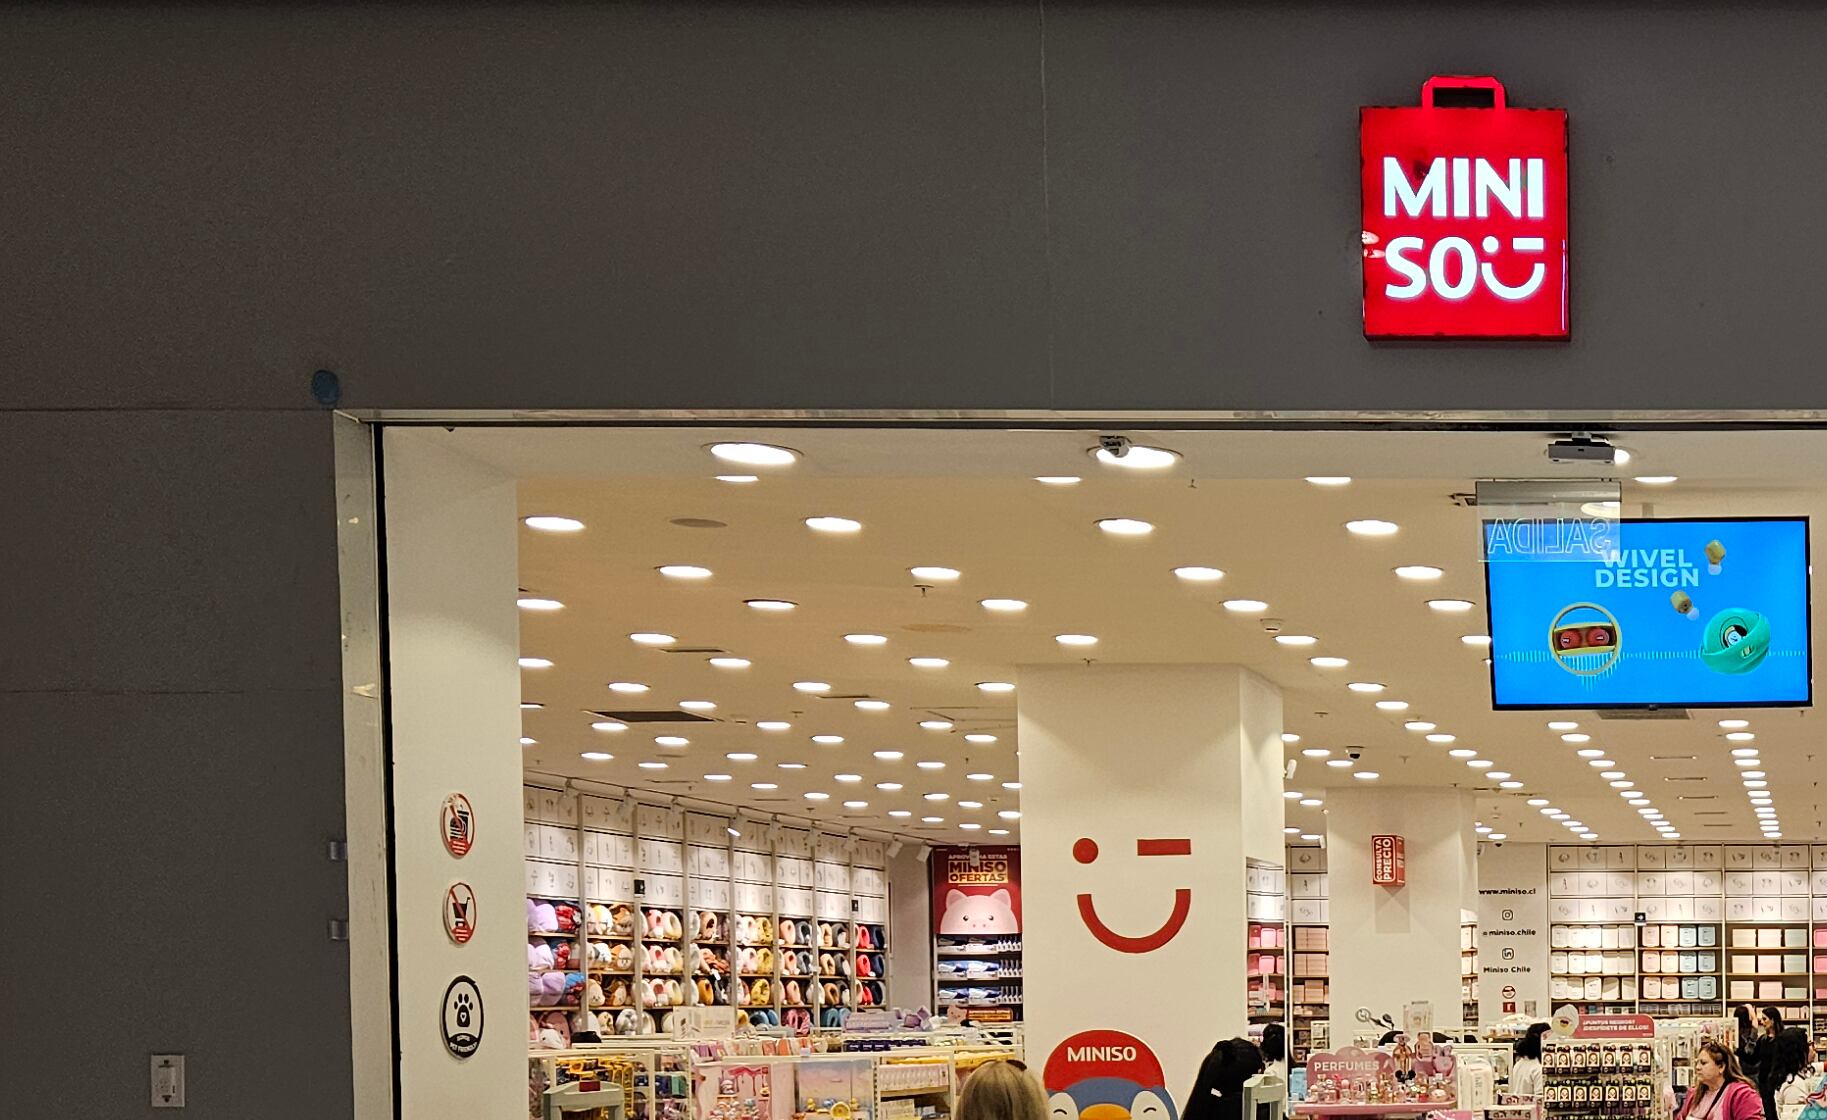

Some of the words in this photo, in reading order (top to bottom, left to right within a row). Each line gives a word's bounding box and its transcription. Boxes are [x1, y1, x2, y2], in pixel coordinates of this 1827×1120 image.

[1383, 156, 1545, 218] MINI
[1601, 549, 1693, 569] WIVEL
[1595, 568, 1700, 588] DESIGN
[949, 861, 1007, 873] MINISO
[1382, 838, 1393, 880] PRECIO
[1478, 887, 1537, 896] www.miniso.cl
[1483, 966, 1509, 974] Miniso
[1511, 965, 1531, 974] Chile
[1066, 1046, 1137, 1062] MINISO
[1314, 1060, 1380, 1072] PERFUMES
